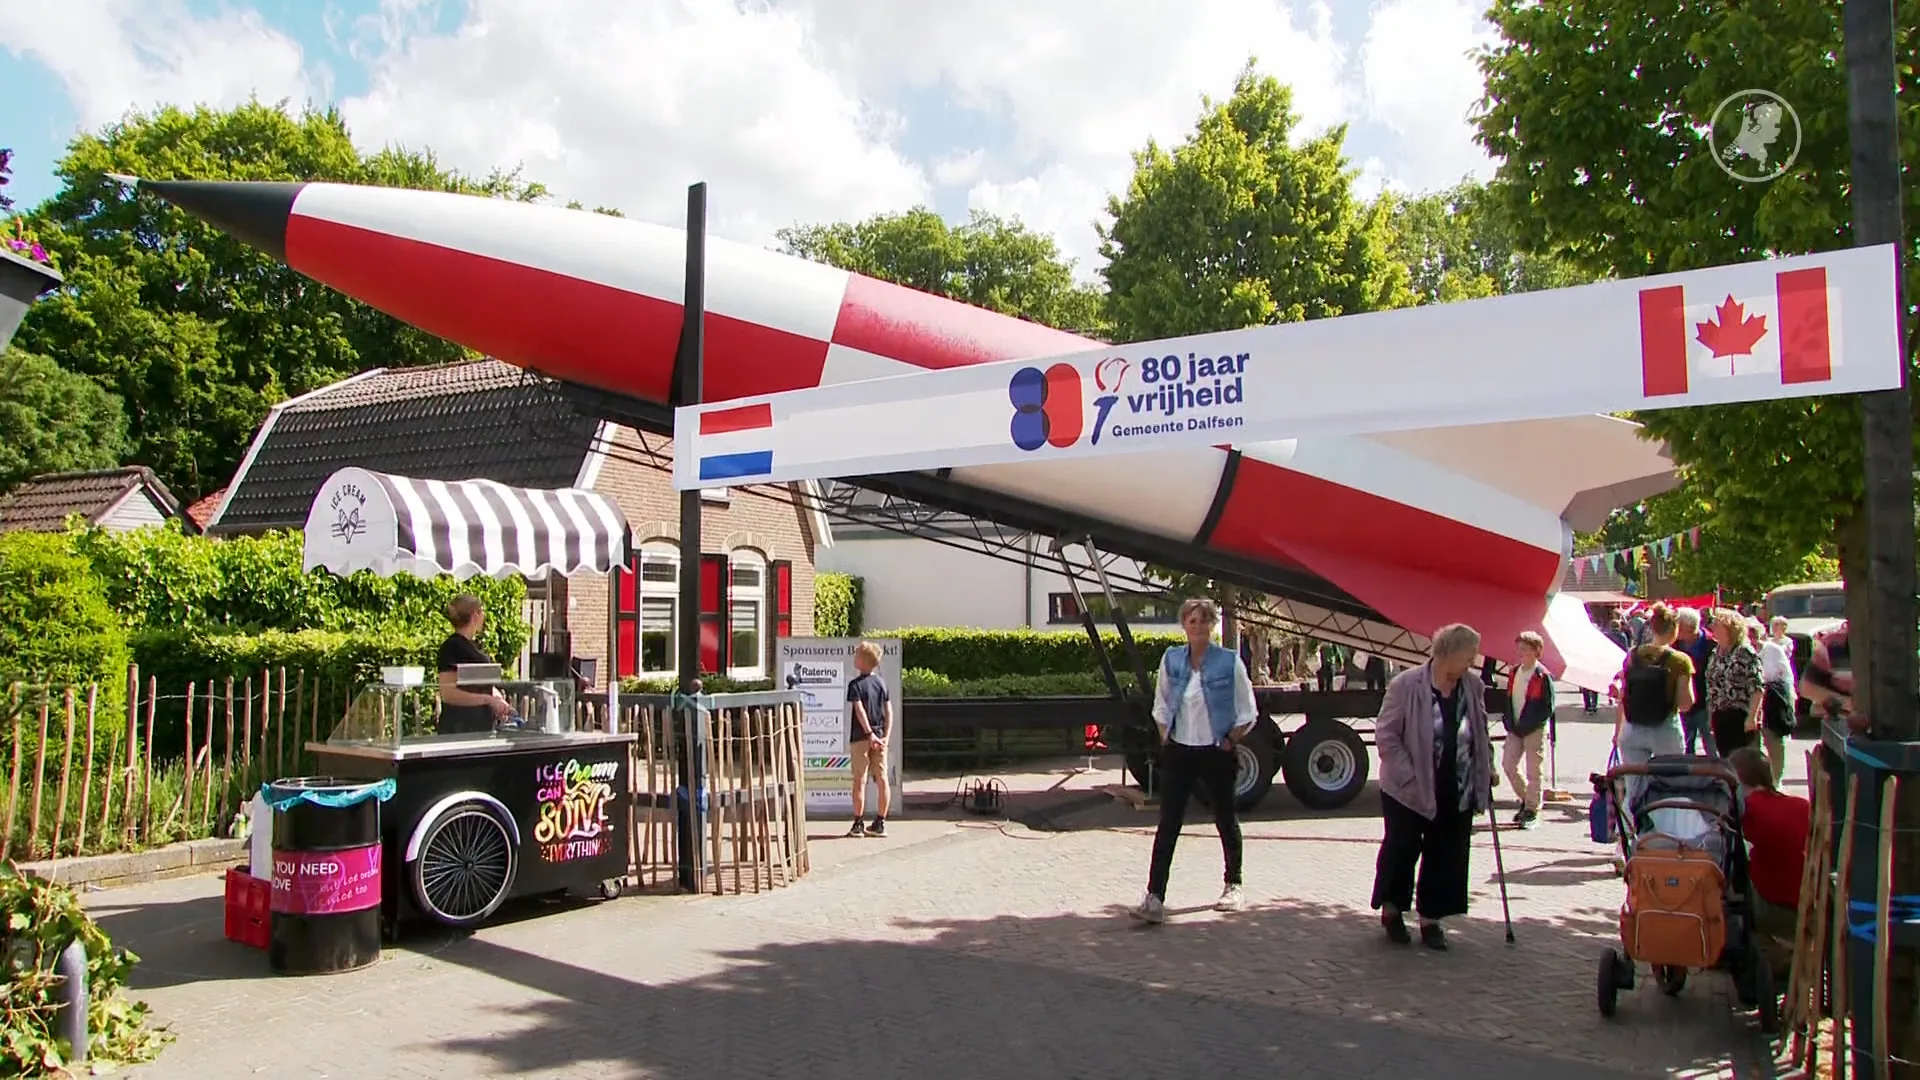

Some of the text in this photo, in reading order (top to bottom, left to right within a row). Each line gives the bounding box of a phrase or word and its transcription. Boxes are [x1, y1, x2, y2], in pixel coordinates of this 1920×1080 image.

[1142, 352, 1250, 385] 80 jaar
[1127, 377, 1243, 416] vrijheid
[1112, 415, 1243, 437] Gemeente Dalfsen
[330, 484, 366, 510] ICE CREAM
[783, 644, 844, 658] Sponsoren
[802, 667, 838, 678] Ratering
[536, 762, 563, 782] ICE
[537, 786, 562, 802] CAN
[534, 782, 617, 843] SOLVE
[275, 860, 296, 876] YOU
[300, 862, 339, 876] NEED
[272, 877, 292, 891] OVE
